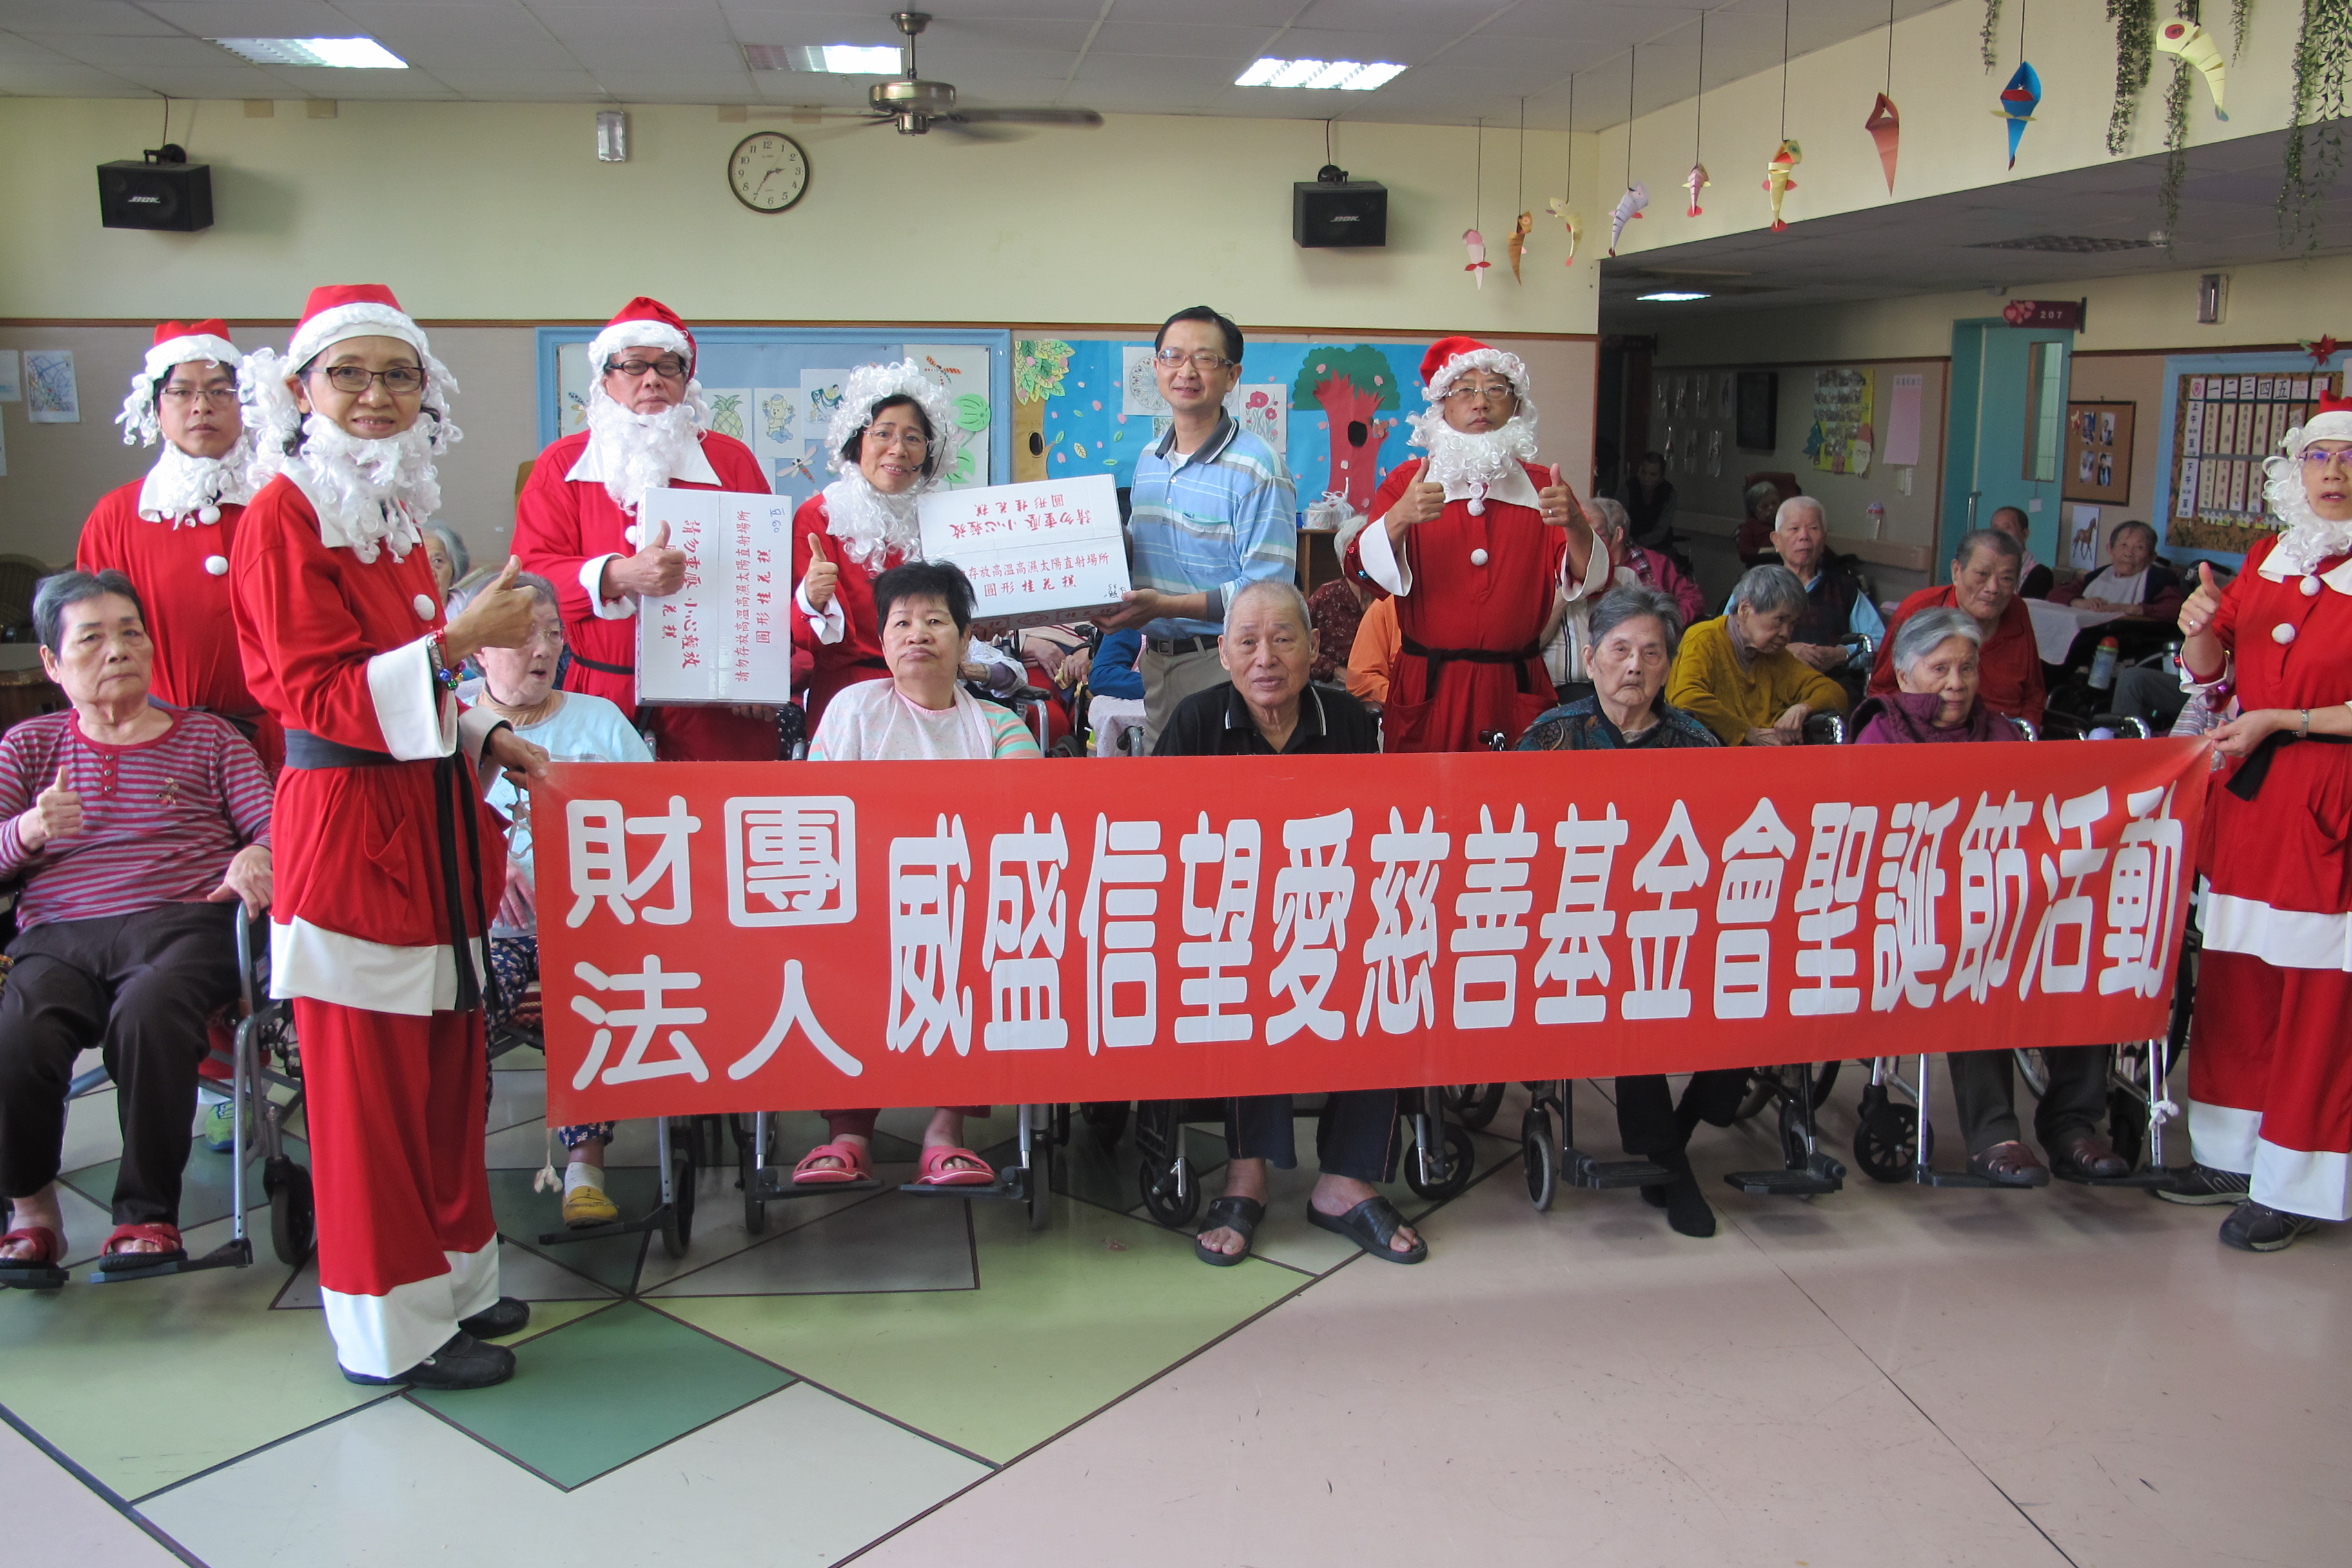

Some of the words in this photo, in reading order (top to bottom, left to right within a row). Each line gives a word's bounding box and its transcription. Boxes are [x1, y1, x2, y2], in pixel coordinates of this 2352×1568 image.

[750, 145, 756, 153] 11
[763, 141, 772, 149] 12
[738, 170, 744, 178] 9
[795, 167, 801, 175] 3
[742, 182, 749, 191] 8
[767, 197, 774, 205] 6
[781, 191, 788, 200] 5
[2039, 311, 2063, 319] 207
[2224, 381, 2237, 395] 二
[2241, 379, 2253, 395] 三
[2259, 382, 2271, 396] 四
[2275, 380, 2288, 398] 五
[2295, 382, 2304, 395] 六
[1024, 509, 1092, 531] 請勿重壓
[949, 519, 1017, 539] 小心輕放
[961, 552, 1110, 580] 存放高溫高濕太陽直射場所
[681, 597, 701, 669] 小心輕放
[565, 794, 858, 928] 財團
[886, 779, 2183, 1057] 威盛信望愛慈善基金會聖誕節活動
[571, 954, 864, 1090] 法人
